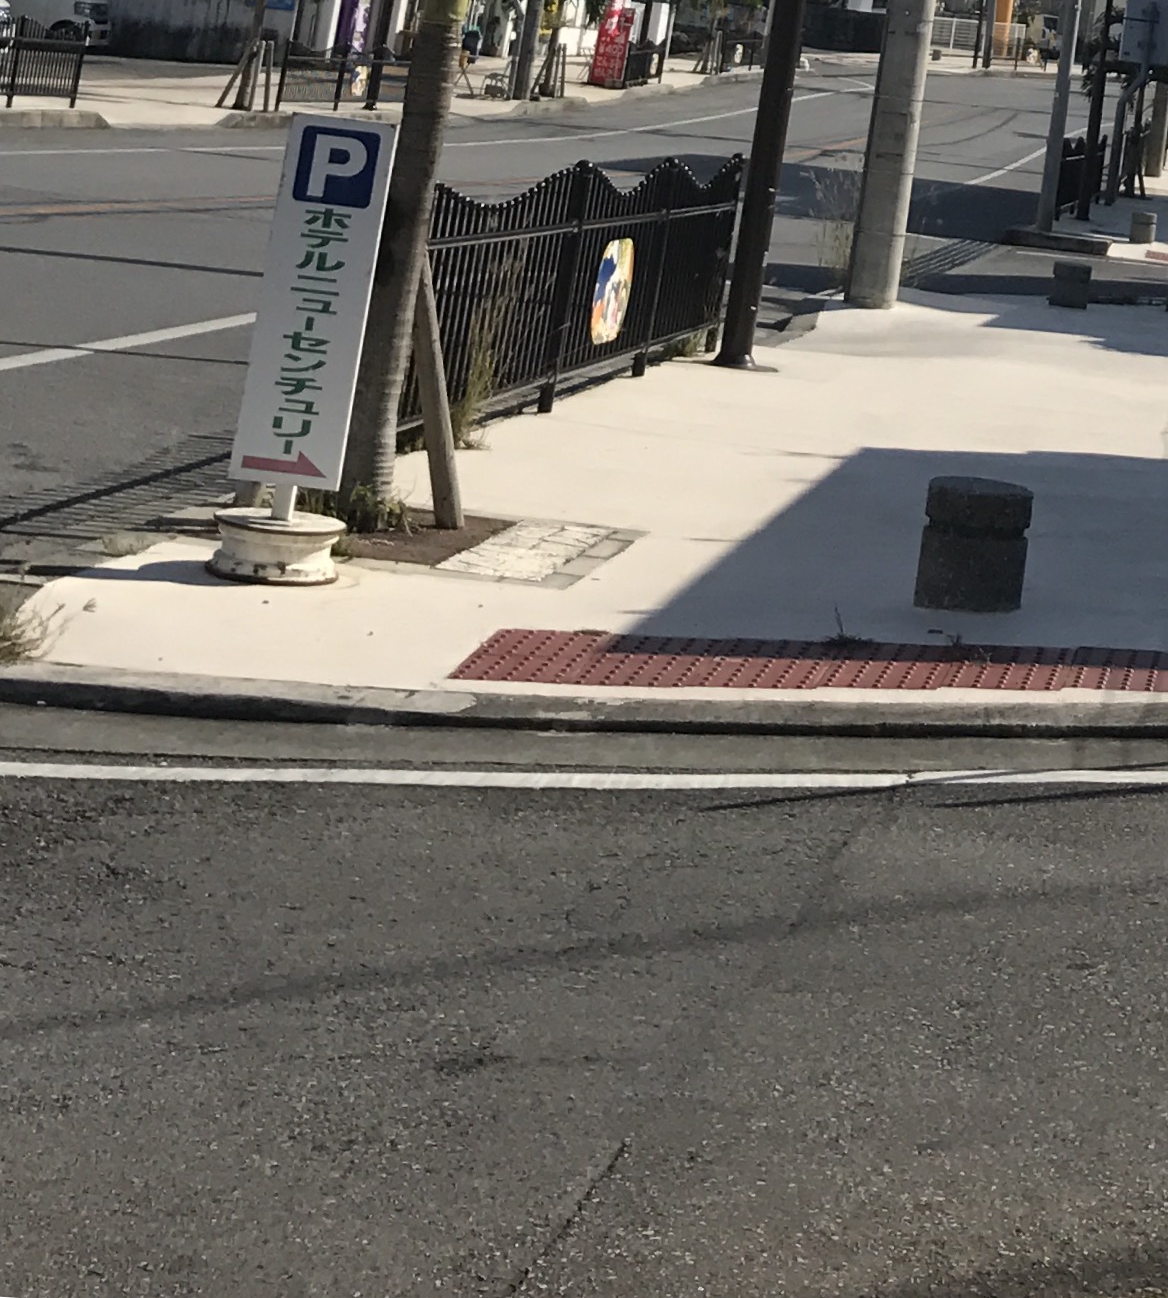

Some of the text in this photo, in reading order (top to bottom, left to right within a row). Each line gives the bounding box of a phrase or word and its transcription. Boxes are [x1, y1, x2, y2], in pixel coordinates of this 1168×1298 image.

[306, 132, 368, 198] P
[271, 207, 353, 456] ホテルニューセンチュリー
